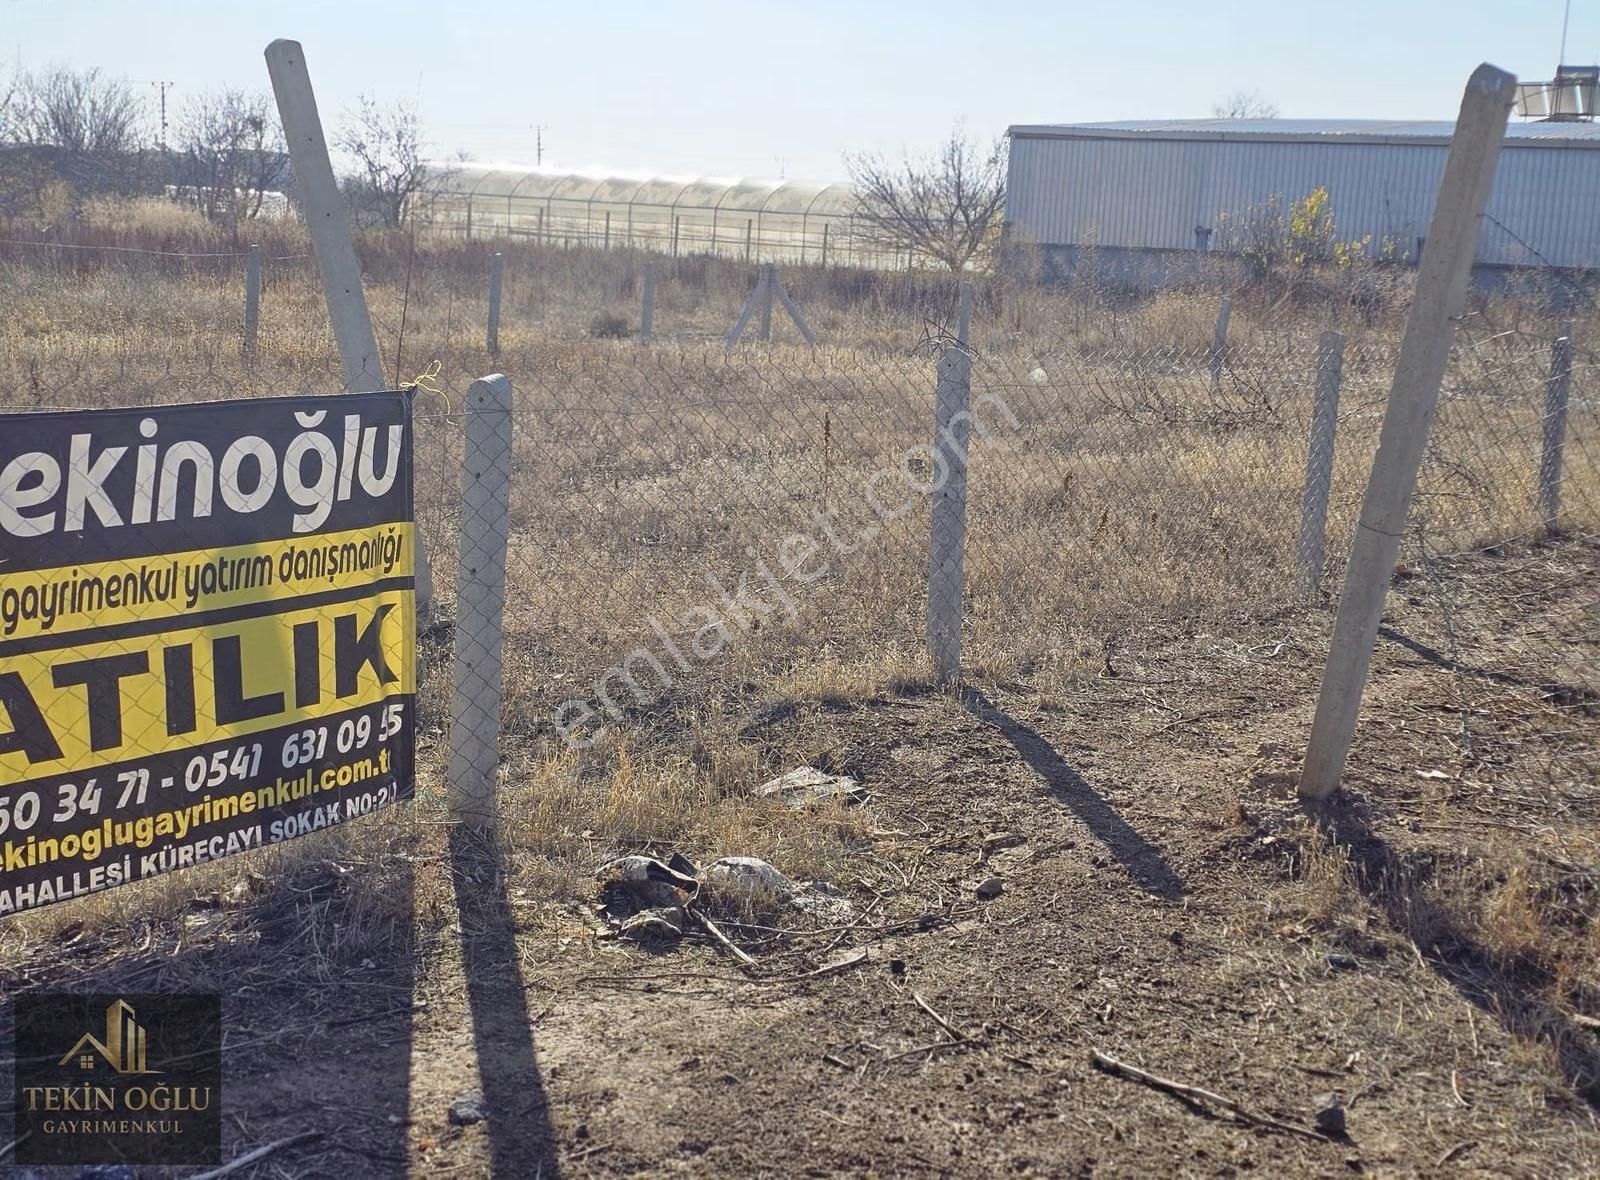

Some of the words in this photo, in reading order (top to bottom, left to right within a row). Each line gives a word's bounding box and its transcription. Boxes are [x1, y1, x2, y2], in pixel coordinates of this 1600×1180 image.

[0, 409, 404, 538] ekinoğlu
[1, 560, 179, 636] gayrimenkul
[184, 553, 273, 609] yatırım
[279, 526, 403, 585] danışmanlığı
[0, 747, 392, 873] kinoglugayrimenkul.com.t
[53, 778, 103, 822] 34
[116, 768, 150, 809] 71
[184, 743, 263, 792] 0541
[281, 726, 328, 769] 631
[336, 714, 372, 753] 09
[0, 854, 132, 916] AHALLESİ
[269, 801, 340, 843] SOKAK
